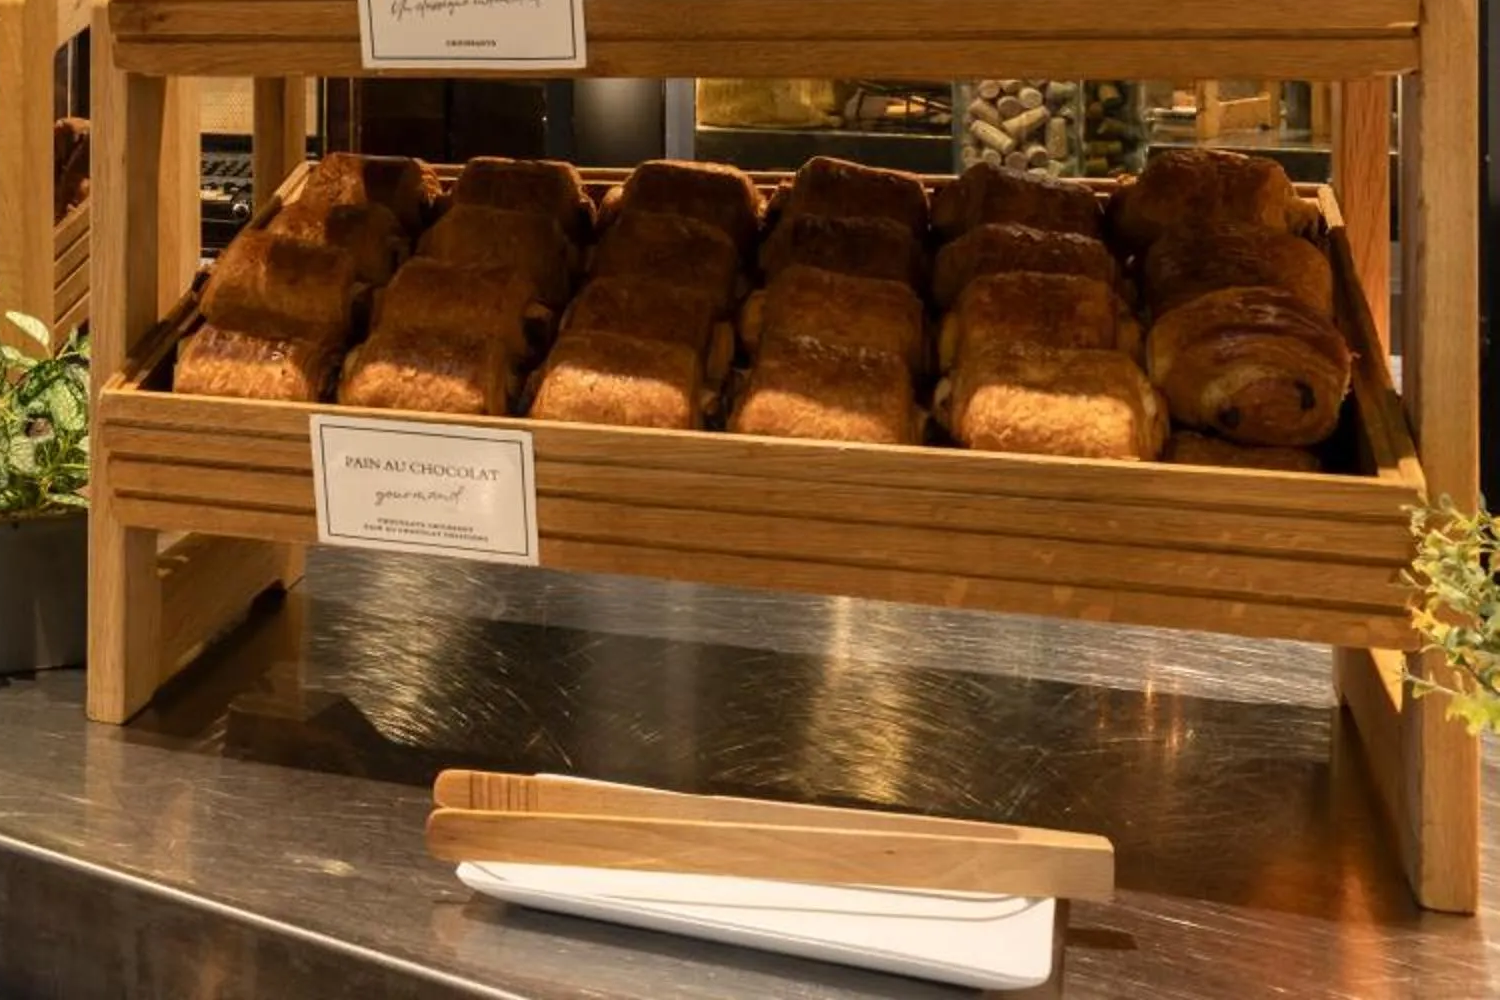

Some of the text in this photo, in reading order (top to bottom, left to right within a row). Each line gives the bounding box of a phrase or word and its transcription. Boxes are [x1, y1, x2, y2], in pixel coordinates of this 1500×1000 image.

[345, 455, 500, 481] PAIN AU CHOCOLAT
[373, 485, 465, 506] gourmand
